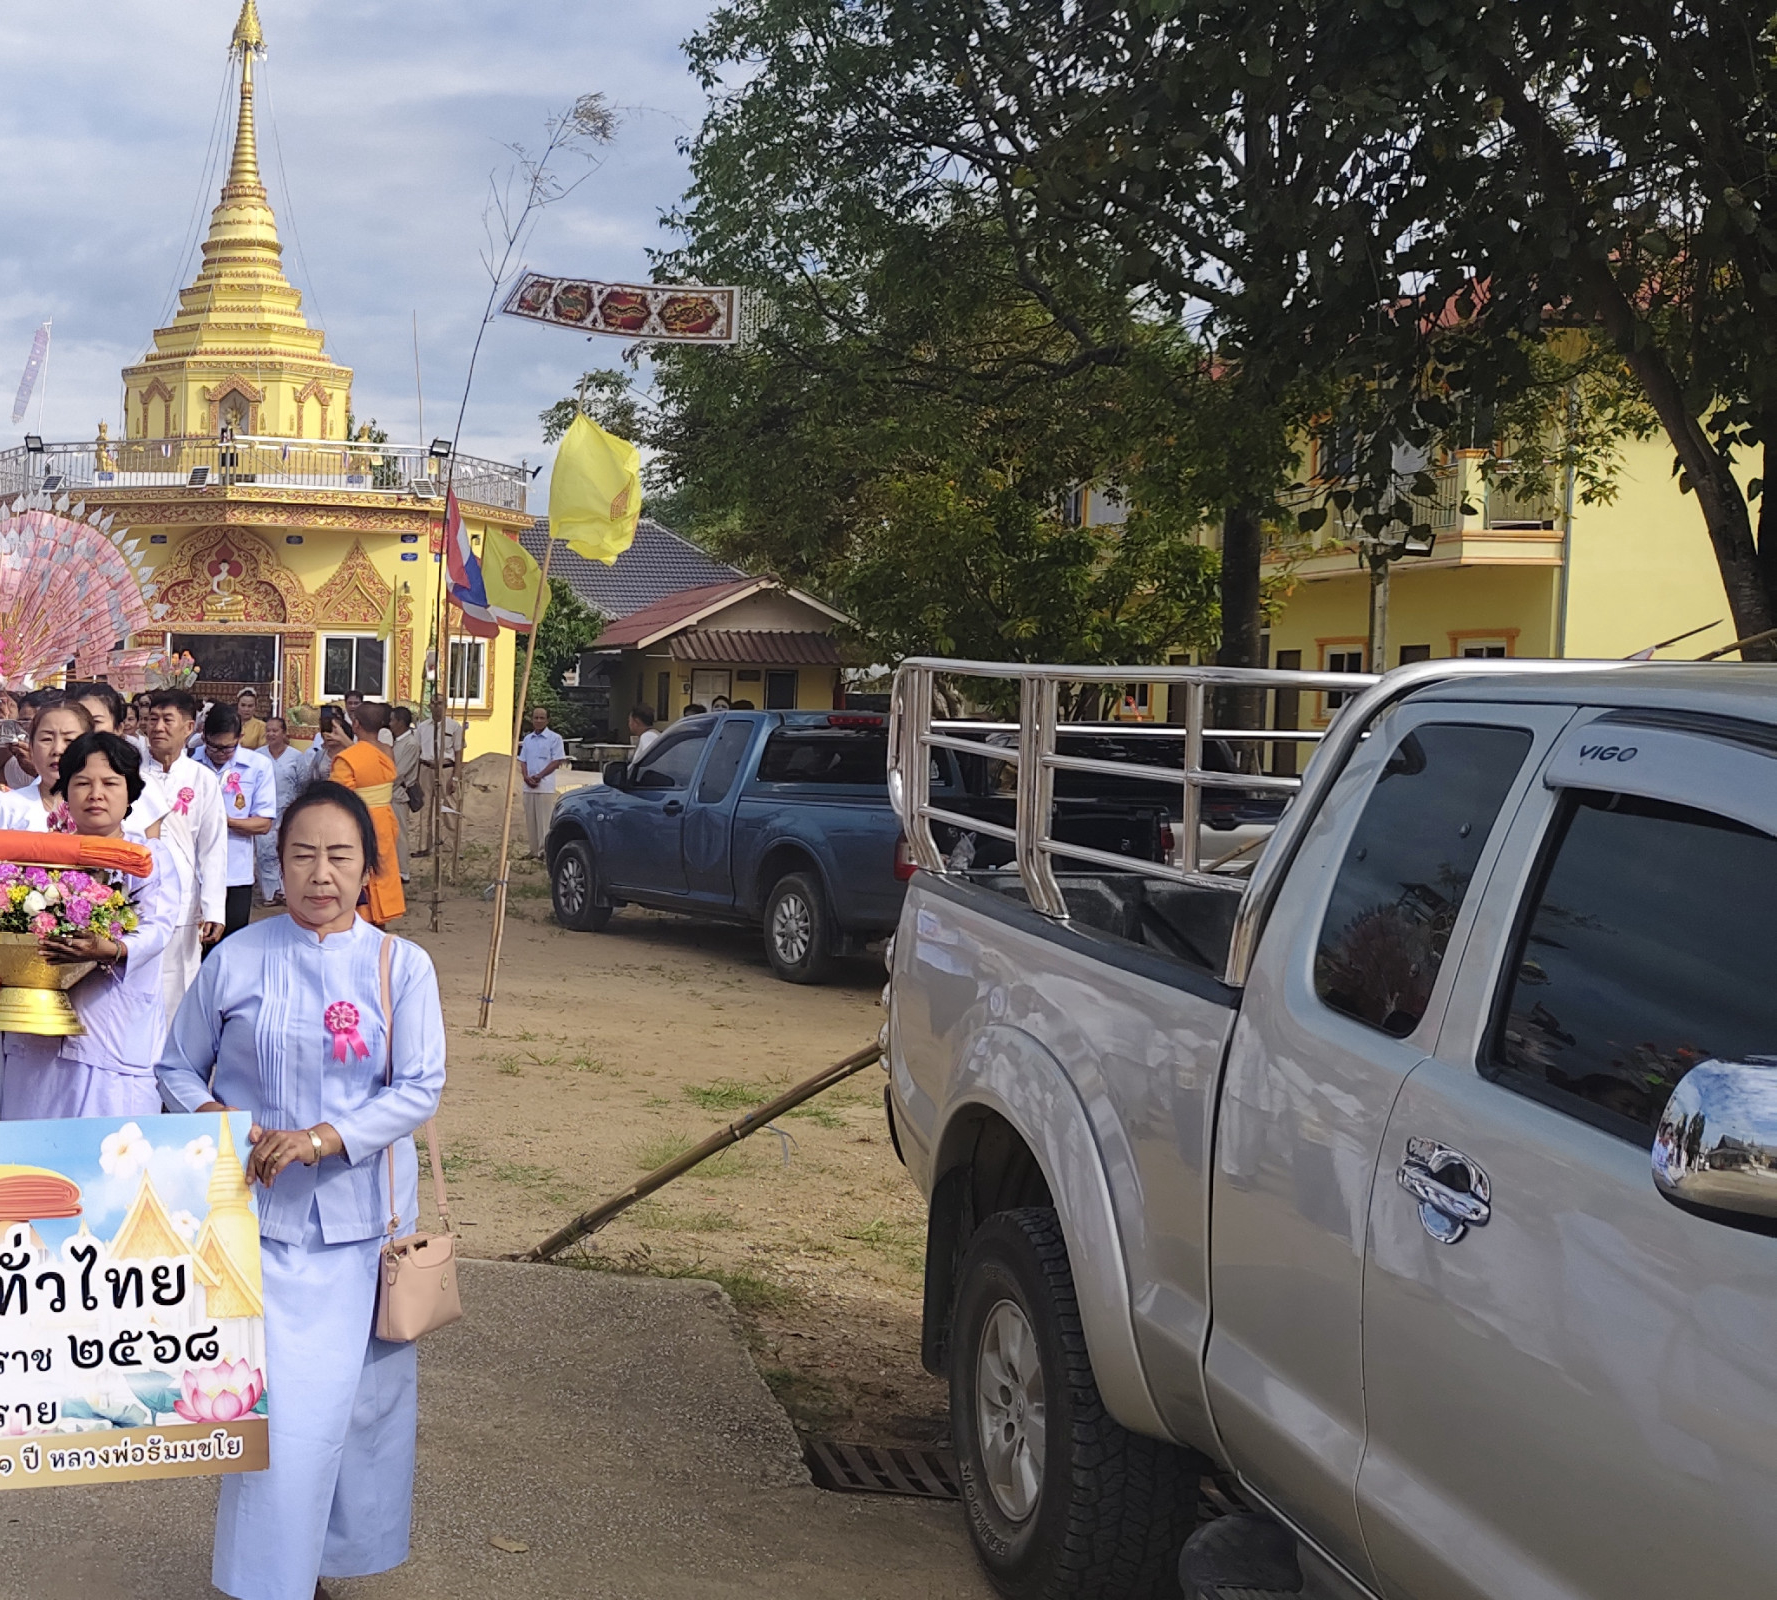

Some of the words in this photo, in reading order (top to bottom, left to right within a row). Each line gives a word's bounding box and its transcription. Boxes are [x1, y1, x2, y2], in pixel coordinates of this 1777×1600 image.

[1580, 745, 1638, 762] VIGO
[67, 1325, 220, 1370] ๒๕๖๘
[22, 1445, 40, 1471] ปี
[50, 1432, 242, 1470] หลวงพ่อธัมมชโย
